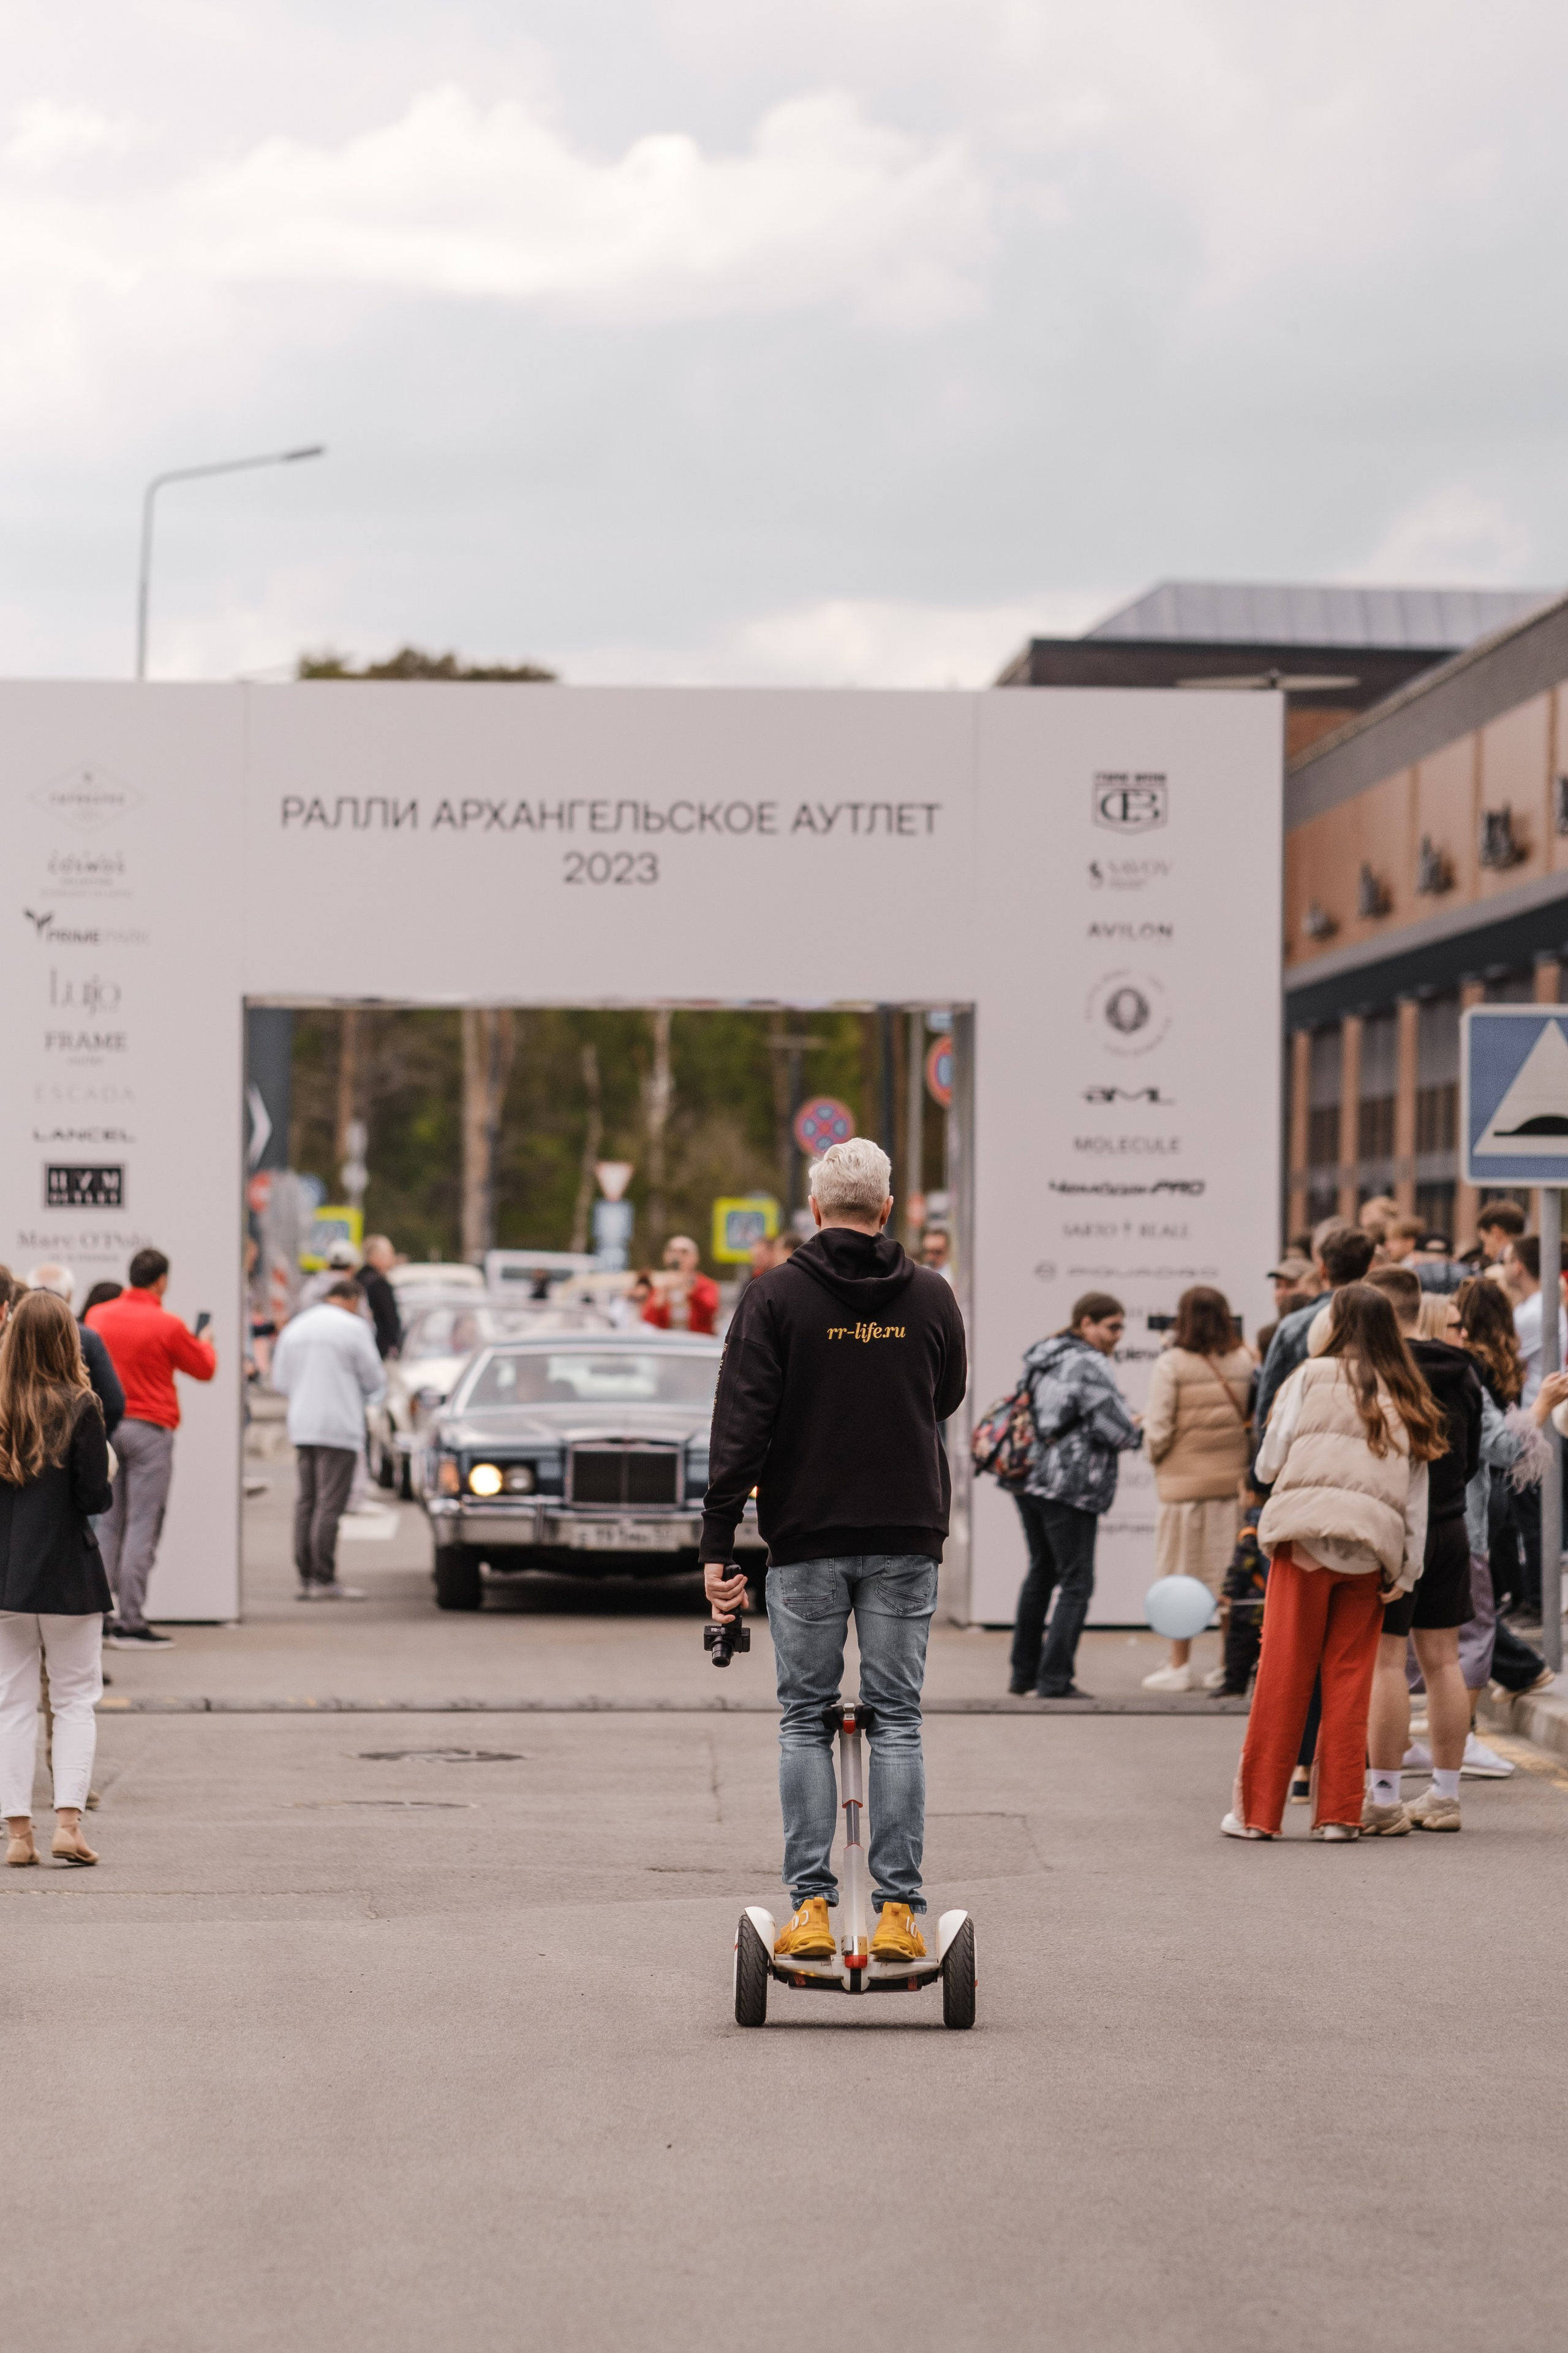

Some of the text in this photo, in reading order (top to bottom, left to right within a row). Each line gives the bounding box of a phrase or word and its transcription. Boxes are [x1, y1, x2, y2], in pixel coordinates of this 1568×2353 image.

[281, 796, 942, 837] РАЛЛИ АРХАНГЕЛЬСКОЕ АУТЛЕТ
[563, 850, 660, 886] 2023
[1088, 921, 1174, 940] AVILON
[45, 1030, 127, 1053] FRAME
[34, 1083, 136, 1104] ESCADA
[32, 1128, 134, 1143] LANCEL
[1073, 1136, 1180, 1154] MOLECULE
[17, 1230, 74, 1249] Marc
[827, 1321, 907, 1343] rr-life.ru
